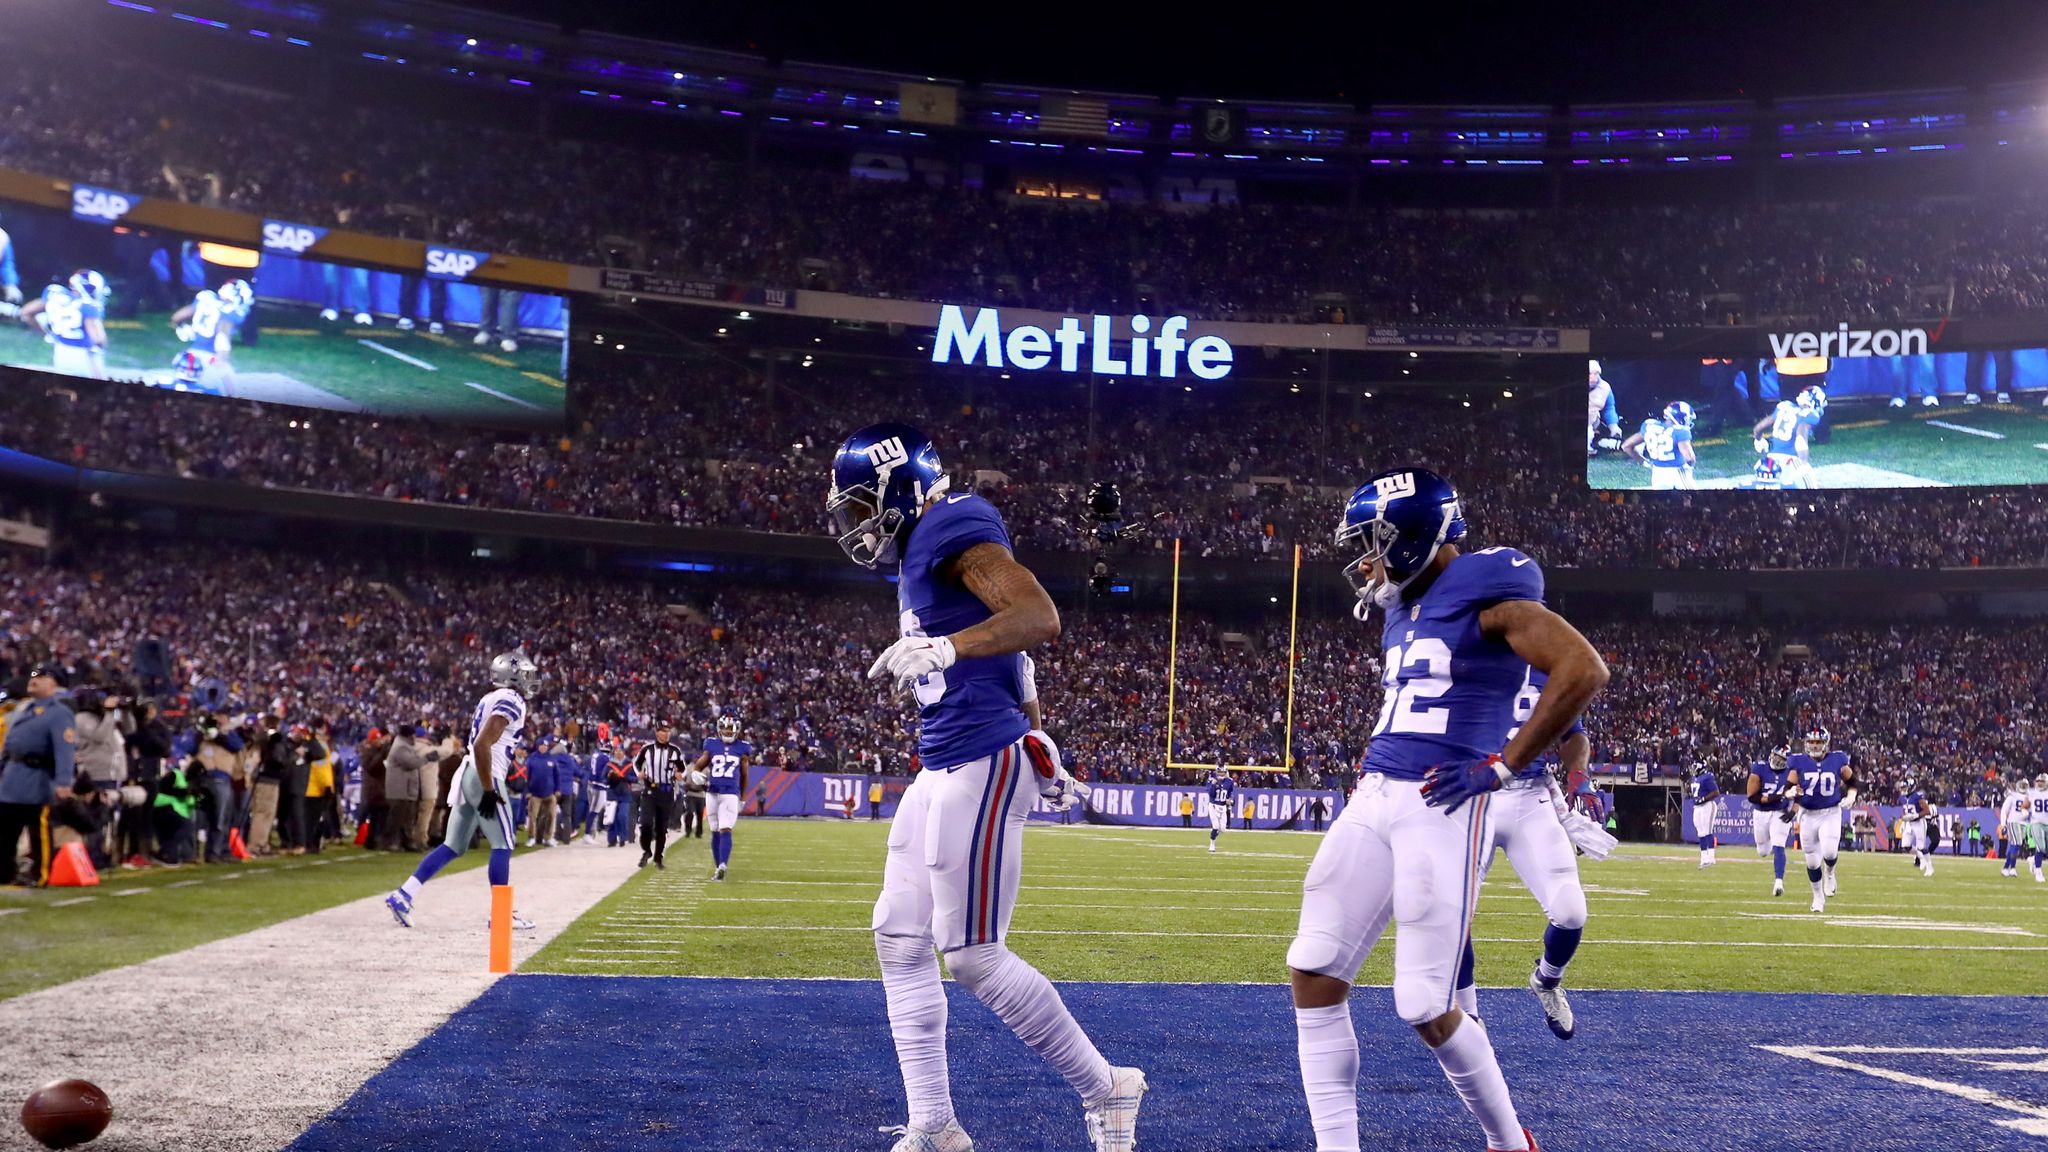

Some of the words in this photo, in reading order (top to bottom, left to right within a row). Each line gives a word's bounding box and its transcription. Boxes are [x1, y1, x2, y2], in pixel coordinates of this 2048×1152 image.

[72, 188, 130, 220] SAP
[263, 223, 315, 252] SAP
[426, 250, 477, 277] SAP
[931, 304, 1234, 380] MetLife
[1768, 322, 1928, 358] verizon
[711, 754, 740, 778] 87
[1215, 789, 1227, 802] 10
[1804, 771, 1836, 797] 70
[1088, 788, 1134, 816] ORK
